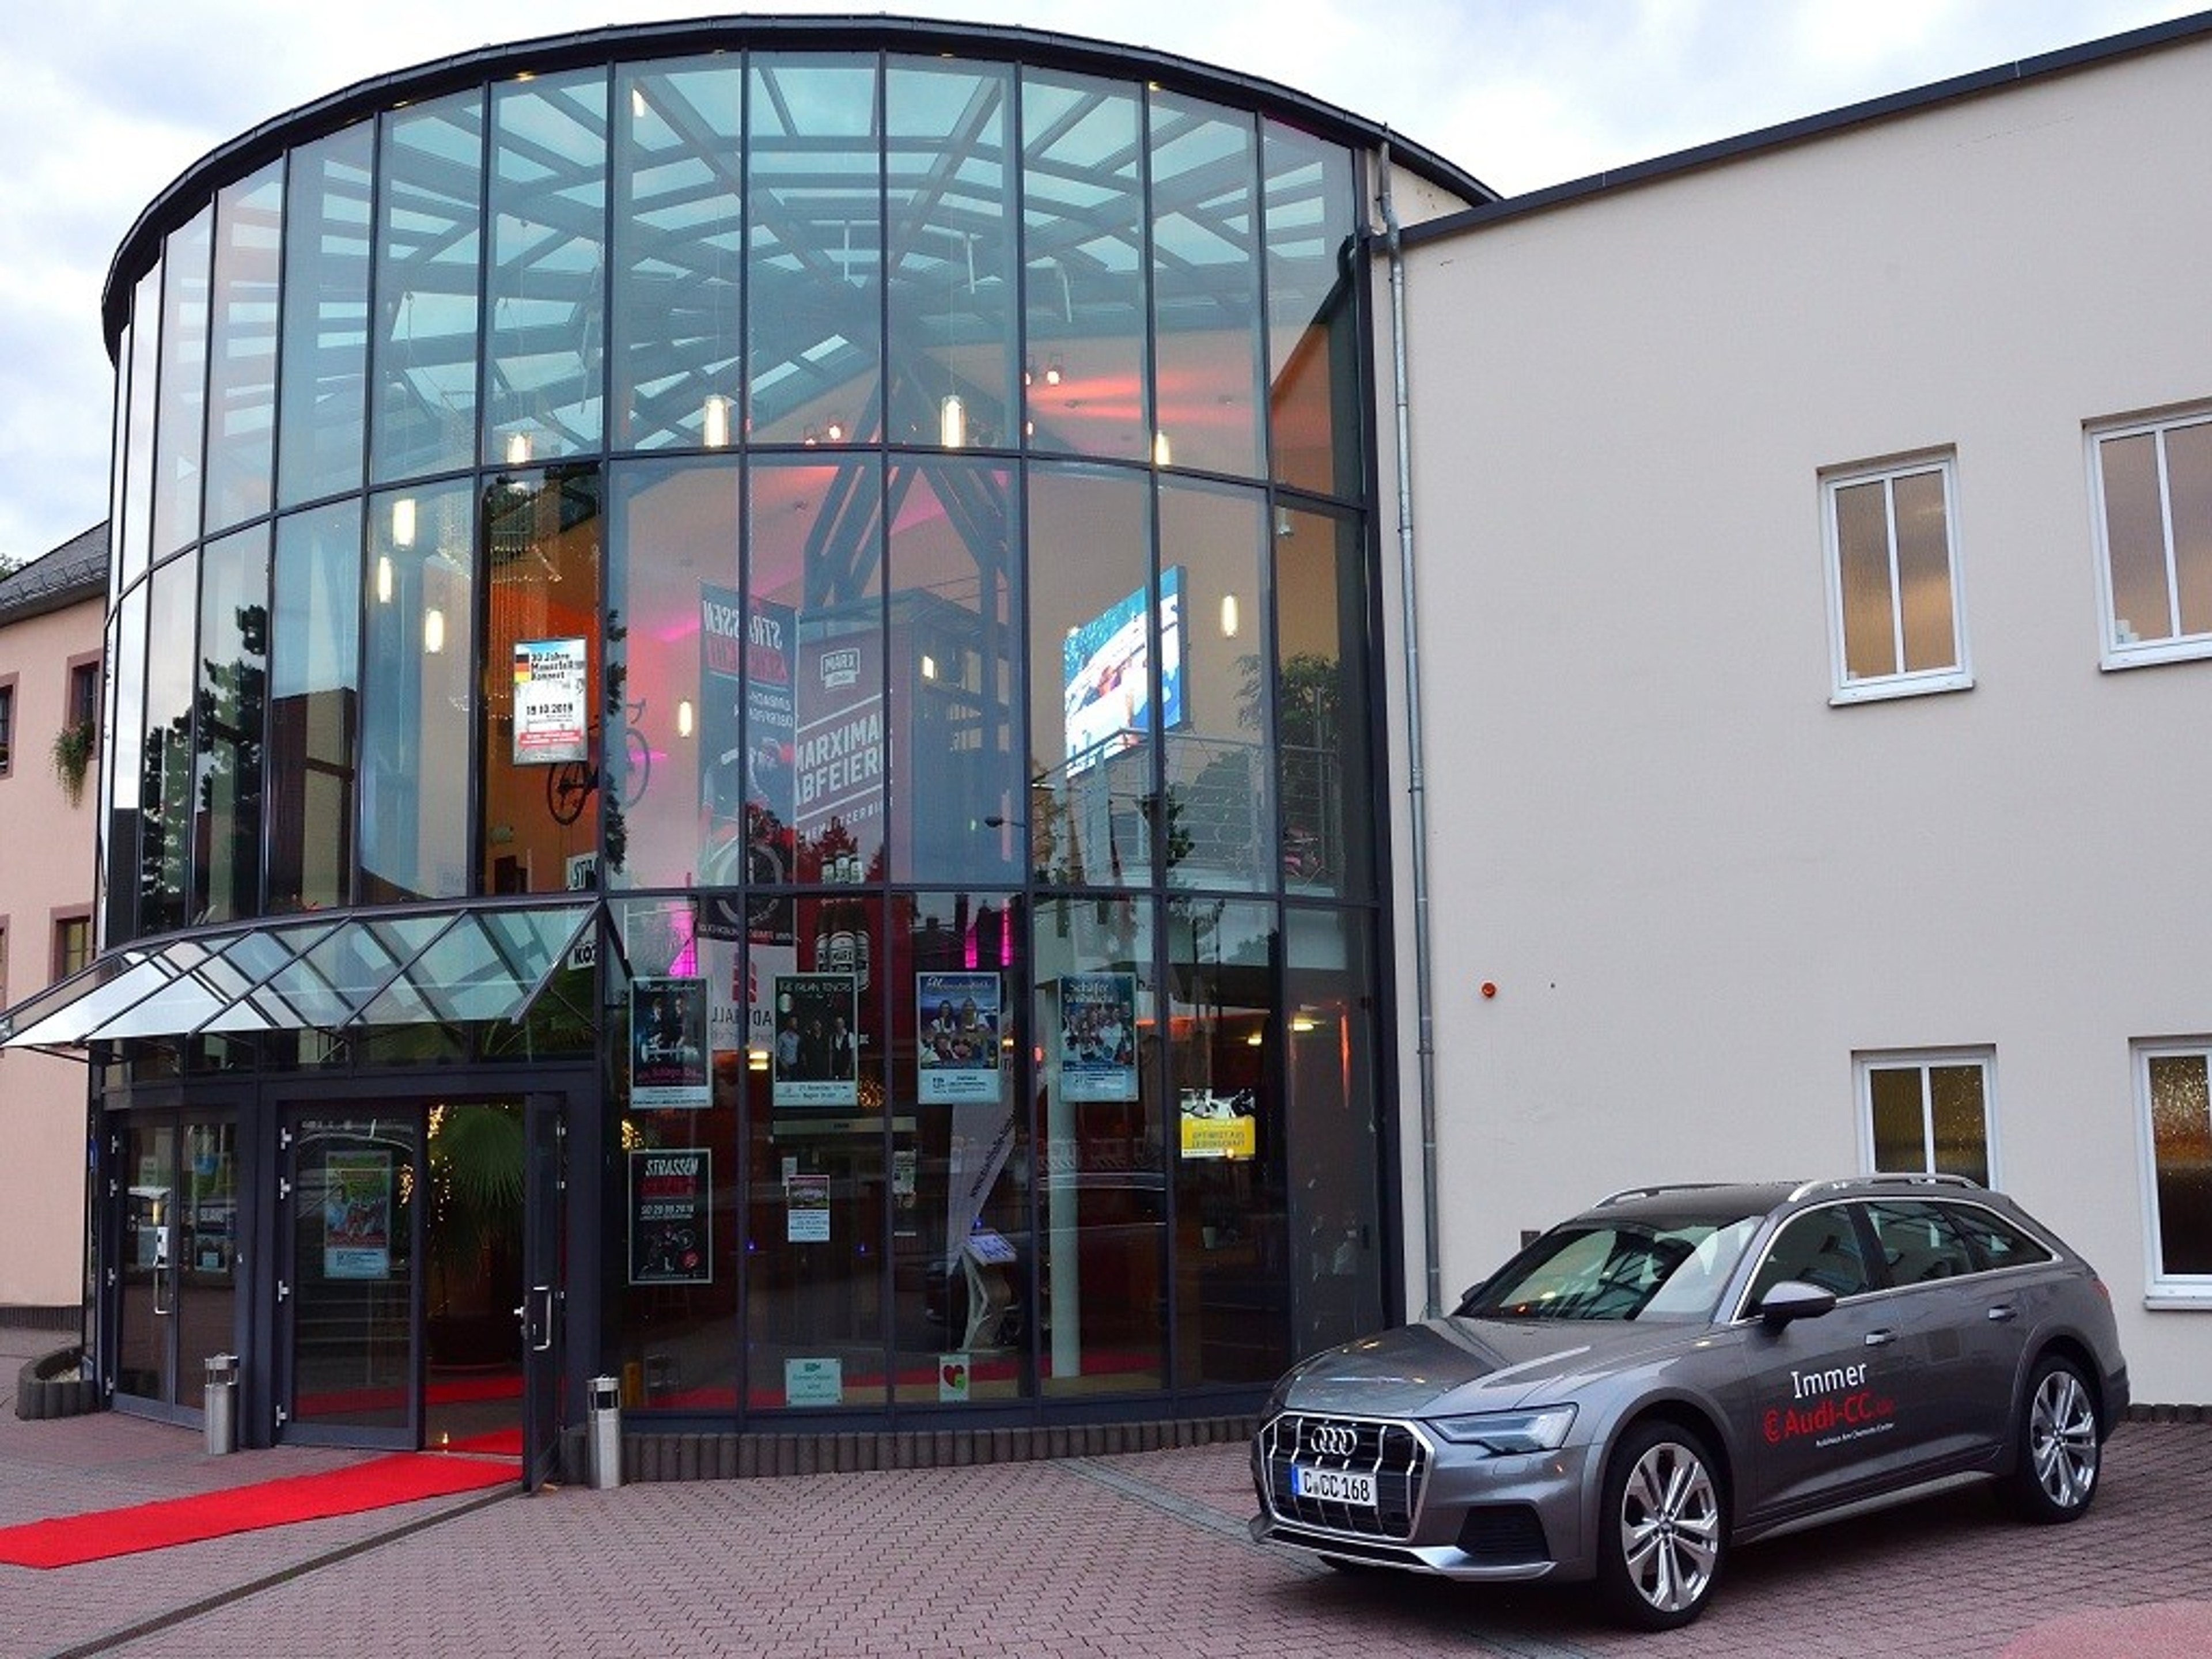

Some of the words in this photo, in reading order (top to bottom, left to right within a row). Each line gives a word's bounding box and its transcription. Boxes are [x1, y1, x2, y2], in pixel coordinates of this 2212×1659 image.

[544, 652, 570, 662] Jahre
[1790, 1363, 1867, 1399] Immer
[1342, 1476, 1370, 1502] 168
